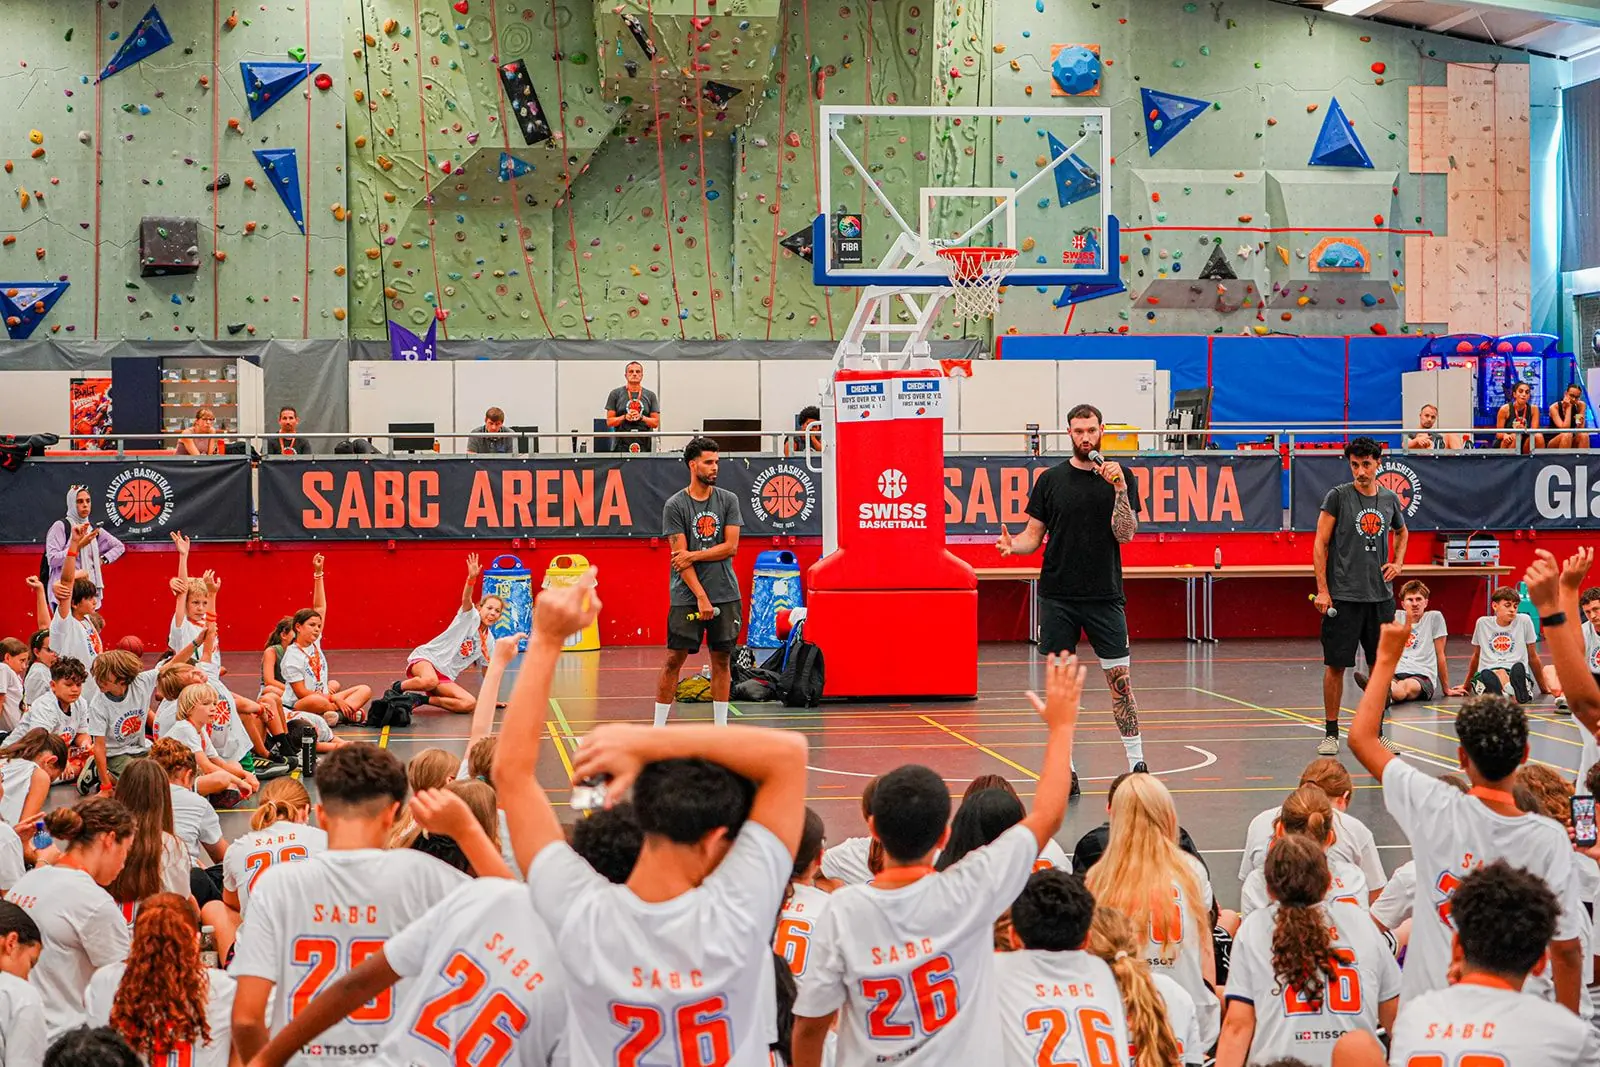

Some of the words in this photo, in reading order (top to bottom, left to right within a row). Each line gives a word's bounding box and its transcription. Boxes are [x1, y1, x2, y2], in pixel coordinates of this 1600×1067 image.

[841, 242, 859, 251] FIBA
[1062, 251, 1095, 259] SWISS
[106, 470, 132, 500] ALLSTAR
[751, 466, 776, 495] ALLSTAR
[301, 470, 440, 529] SABC
[464, 469, 633, 528] ARENA
[1131, 465, 1244, 522] RENA
[1407, 494, 1422, 517] CAMP
[105, 501, 124, 527] SWISS
[158, 501, 174, 526] CAMP
[751, 497, 768, 521] SWISS
[800, 497, 816, 521] CAMP
[859, 503, 927, 520] SWISS
[859, 520, 928, 529] BASKETBALL
[772, 917, 814, 978] 6
[1146, 957, 1175, 966] SSOT
[407, 947, 531, 1067] 26
[858, 951, 960, 1041] 26
[607, 992, 735, 1067] 26
[1022, 1005, 1125, 1067] 26
[1312, 1030, 1348, 1040] TISS
[324, 1043, 379, 1056] TISSOT
